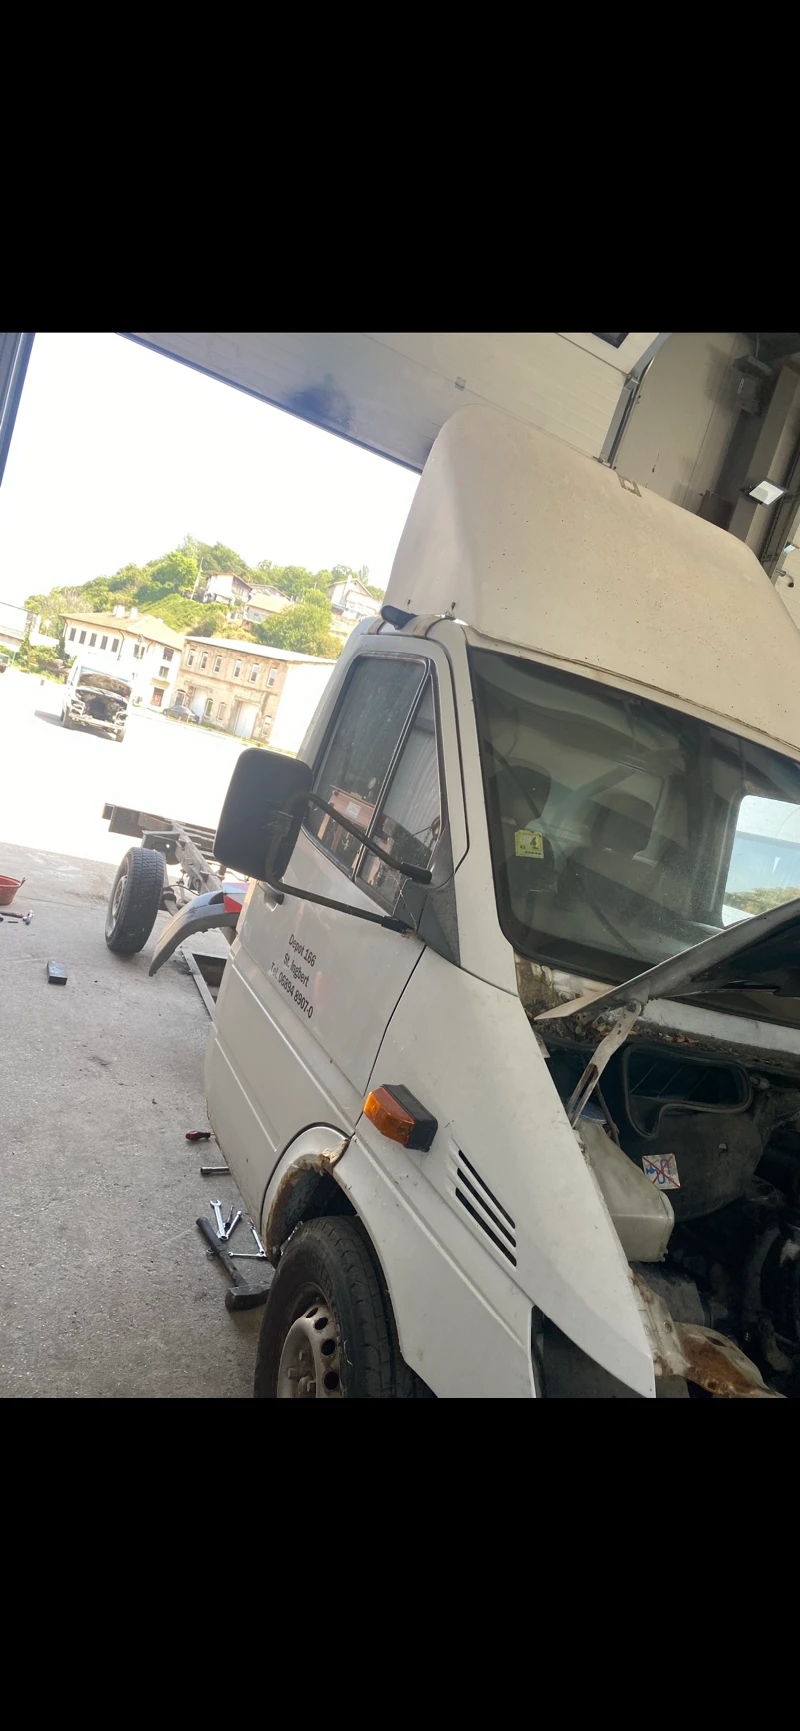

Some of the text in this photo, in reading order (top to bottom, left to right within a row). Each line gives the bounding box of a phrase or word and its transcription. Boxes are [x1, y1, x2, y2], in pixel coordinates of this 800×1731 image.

[289, 934, 316, 966] Depot 166
[290, 960, 309, 987] Ingbert
[270, 962, 314, 1018] Tel. 06894 8907-0
